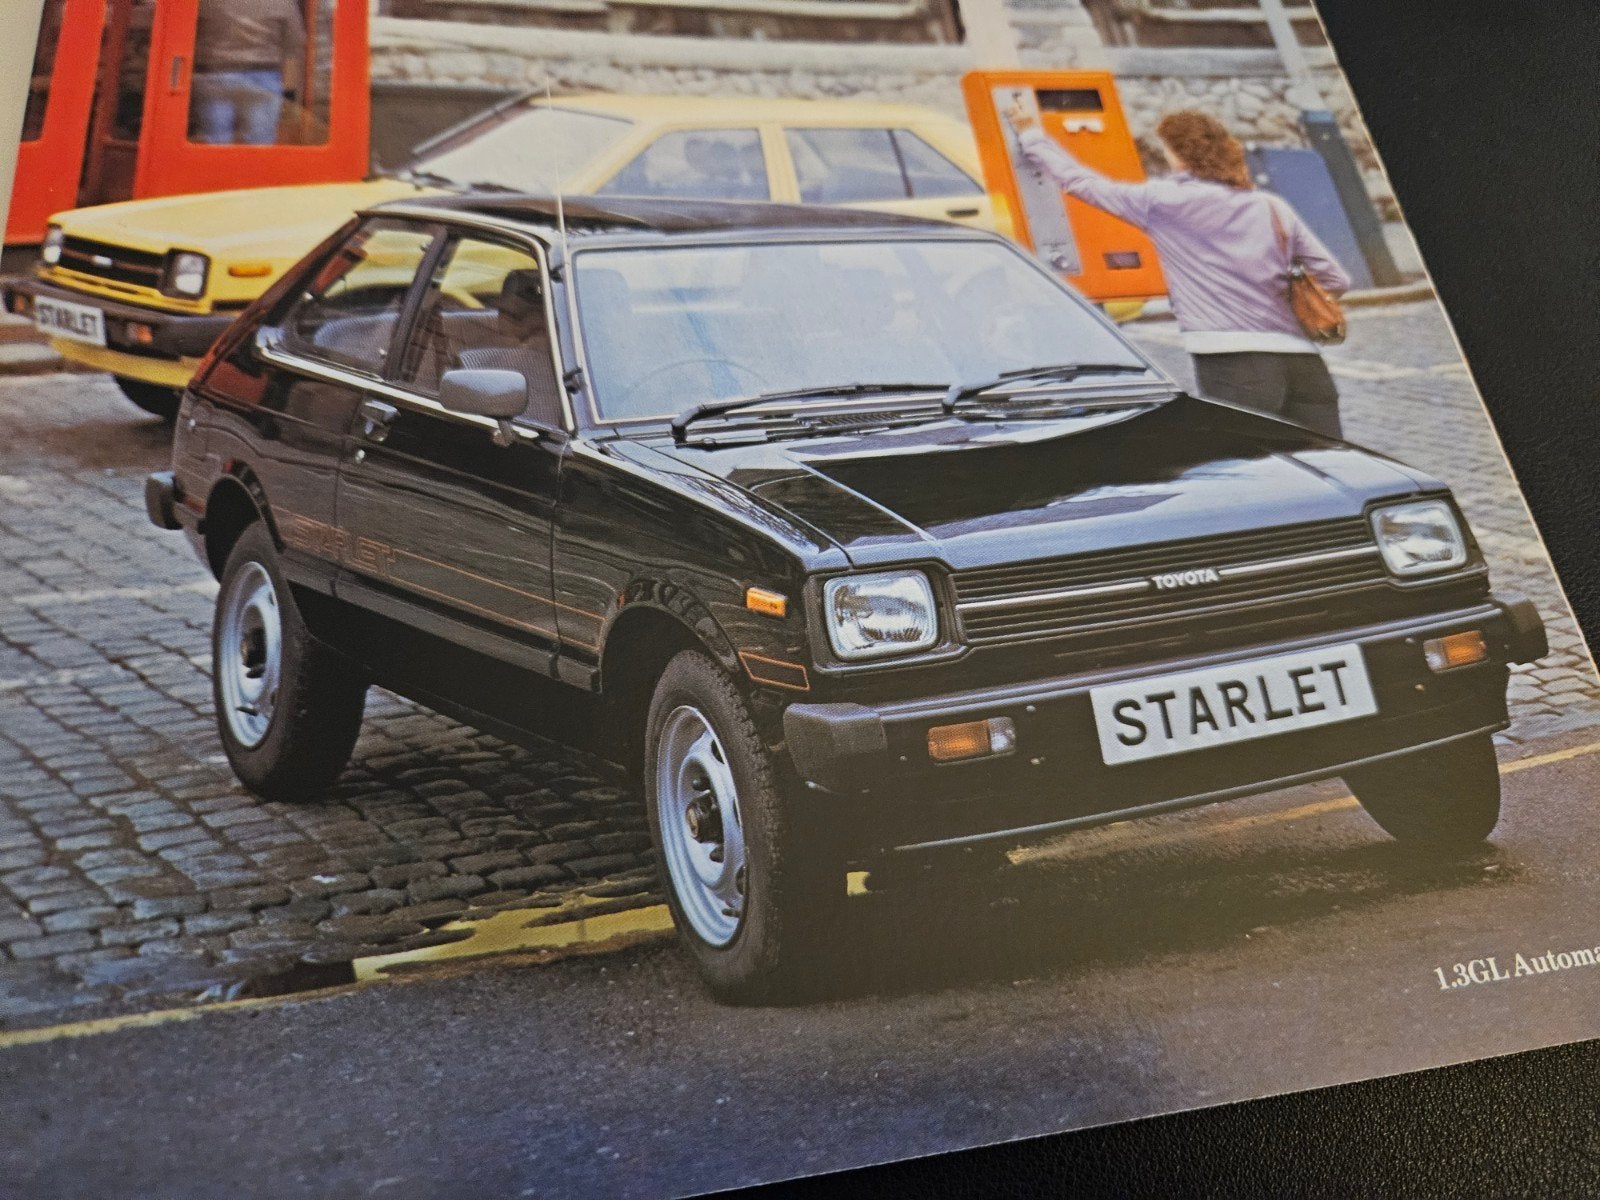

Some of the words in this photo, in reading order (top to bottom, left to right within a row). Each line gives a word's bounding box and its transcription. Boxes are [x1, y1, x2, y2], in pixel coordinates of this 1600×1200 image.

[1151, 568, 1219, 590] TOYOTA
[1111, 659, 1348, 747] STARLET
[1433, 956, 1510, 990] 1.3GL
